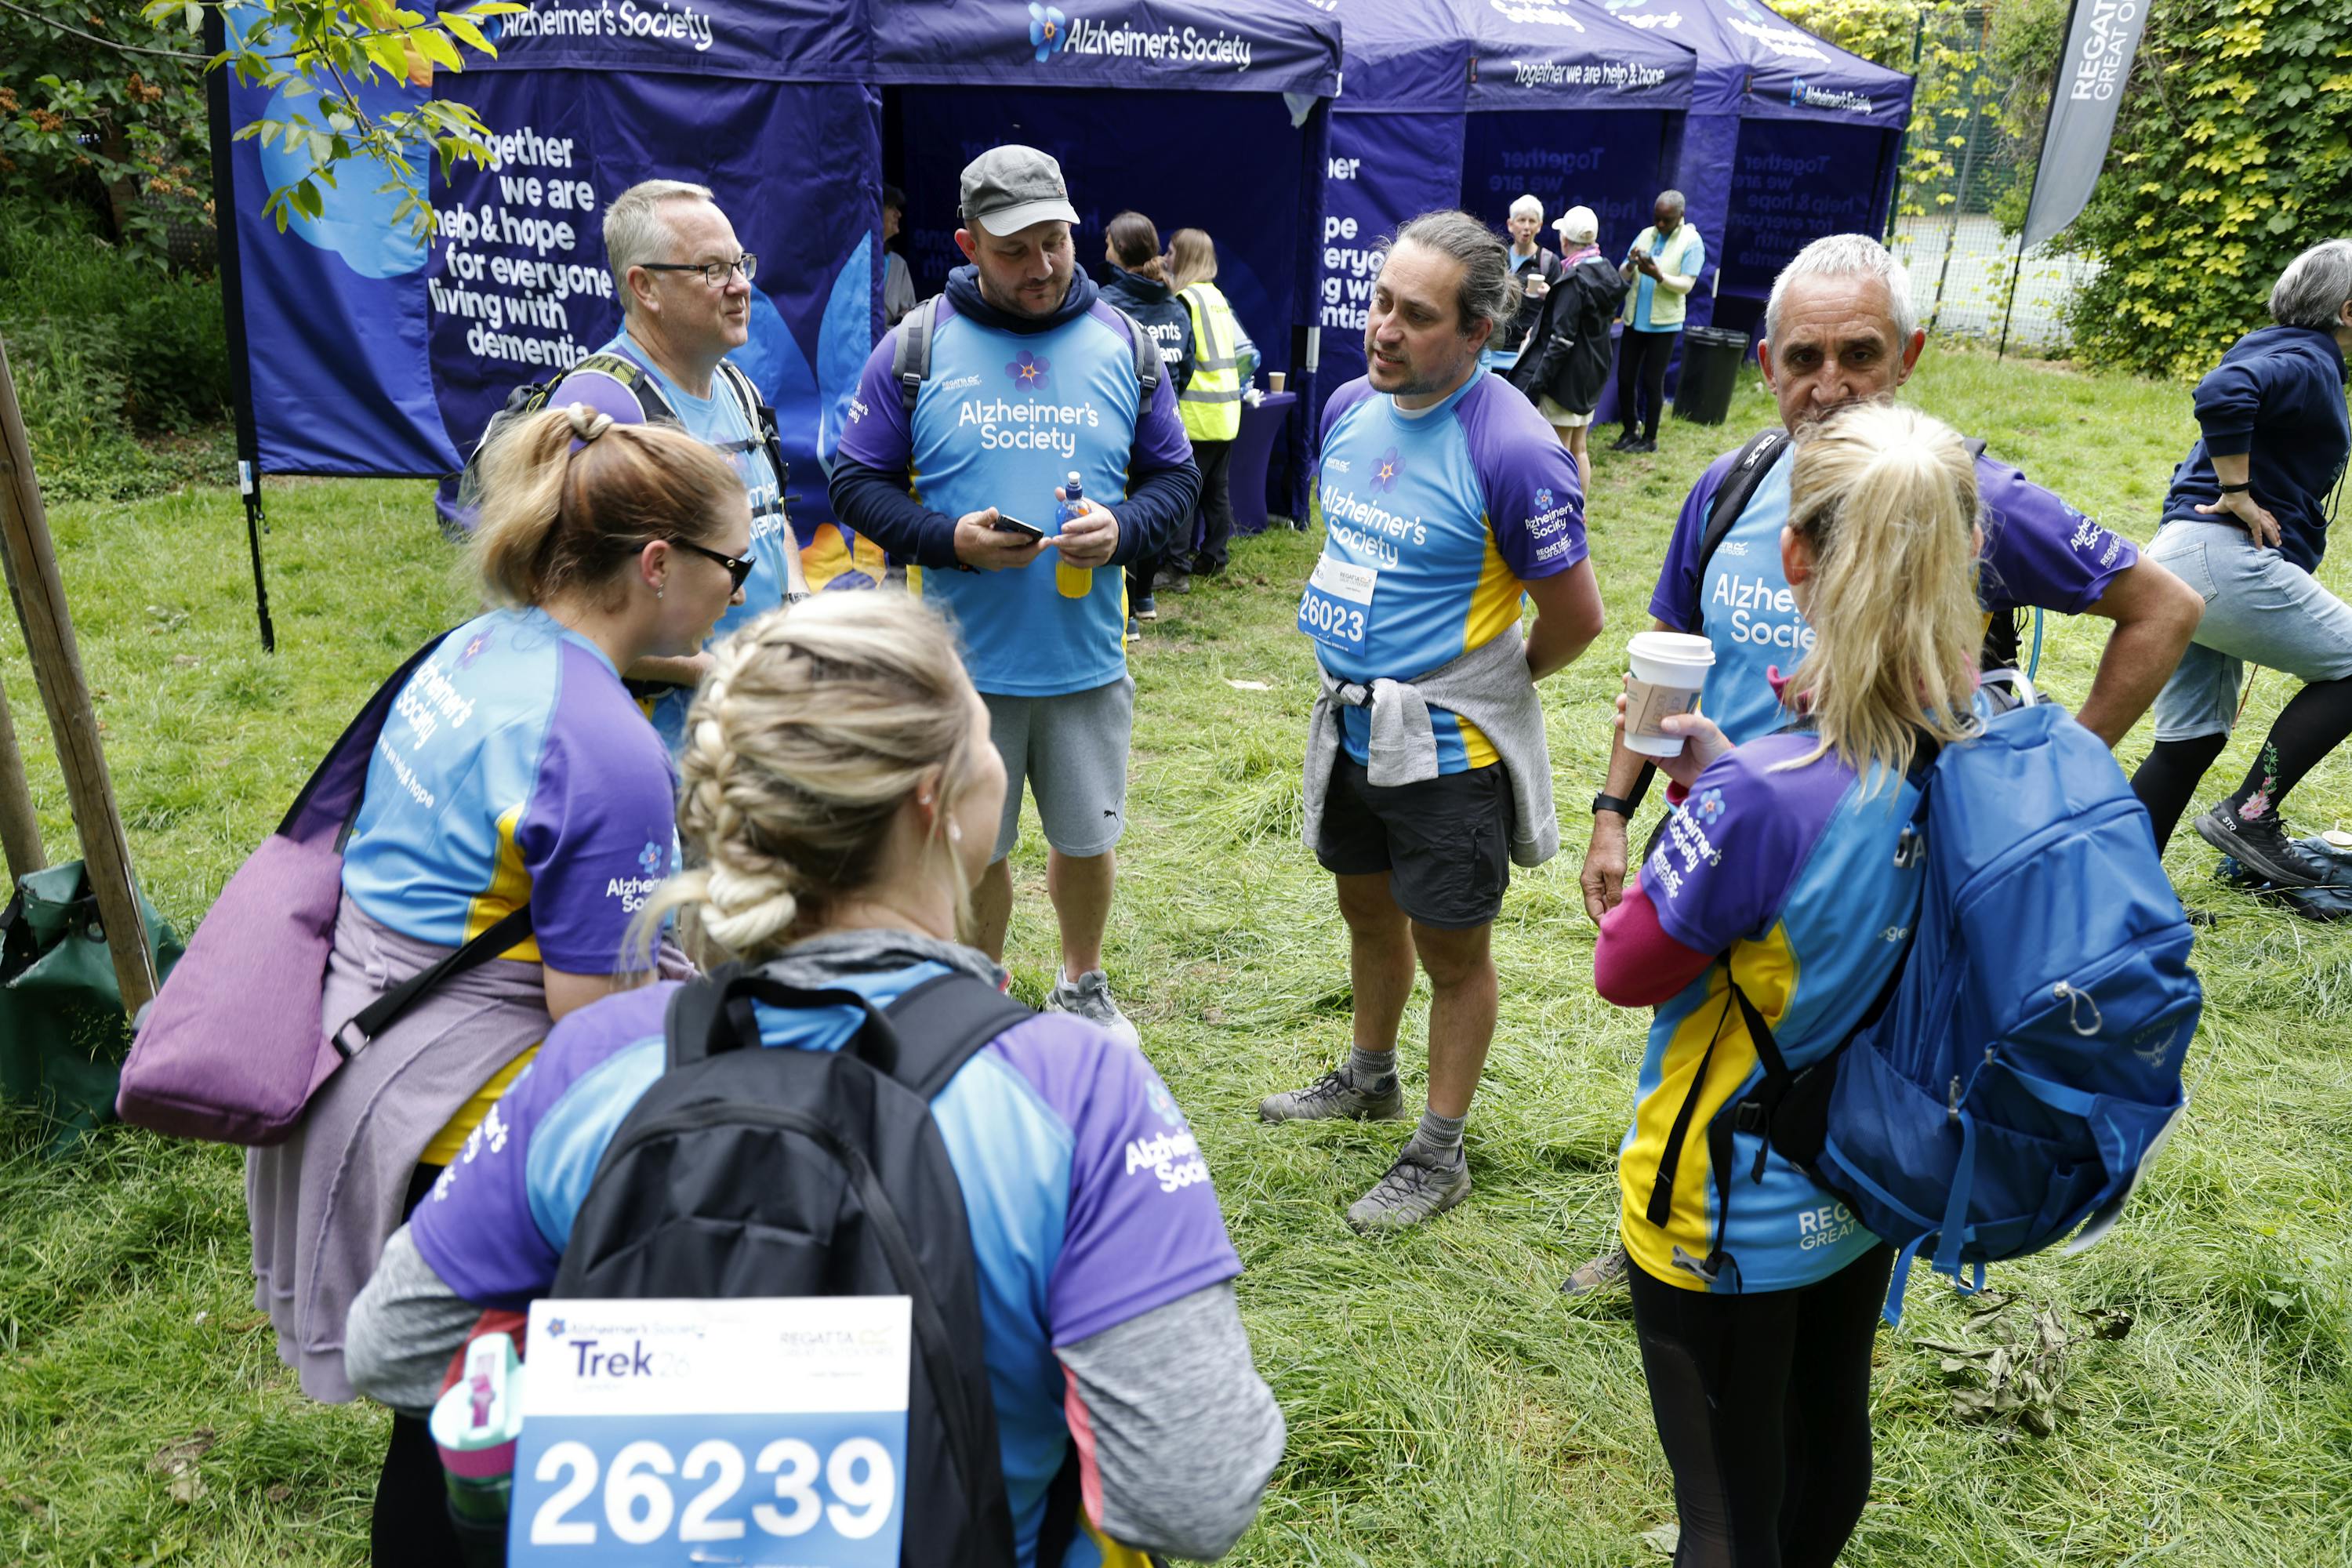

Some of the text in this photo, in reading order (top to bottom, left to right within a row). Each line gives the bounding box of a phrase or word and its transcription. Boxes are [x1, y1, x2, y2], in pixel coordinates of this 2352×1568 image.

[502, 0, 713, 51] Alzheimer's Society
[1064, 18, 1251, 72] Alzheimer's Society
[1511, 60, 1665, 89] Together we are help & hope
[2094, 27, 2128, 100] GREAT
[463, 126, 573, 172] gether
[499, 175, 594, 212] we are
[481, 205, 502, 243] &
[499, 207, 575, 256] hope
[445, 241, 614, 300] for everyone
[1323, 247, 1385, 278] eryo
[428, 278, 568, 330] living with
[1320, 301, 1369, 330] ntia
[466, 322, 593, 370] dementia
[1146, 321, 1181, 341] ents
[958, 397, 1098, 427] Alzheimer's
[981, 423, 1076, 459] Society
[1321, 485, 1427, 546] Alzheimer's
[1330, 515, 1398, 570] Society
[1299, 590, 1364, 642] 26023
[1712, 573, 1796, 612] Alzhe
[413, 655, 476, 729] lzheimer's
[396, 681, 438, 751] Society
[407, 775, 434, 808] hope
[622, 893, 645, 913] So
[1800, 1219, 1857, 1250] GREAT
[568, 1339, 653, 1377] Trek
[530, 1436, 895, 1544] 26239
